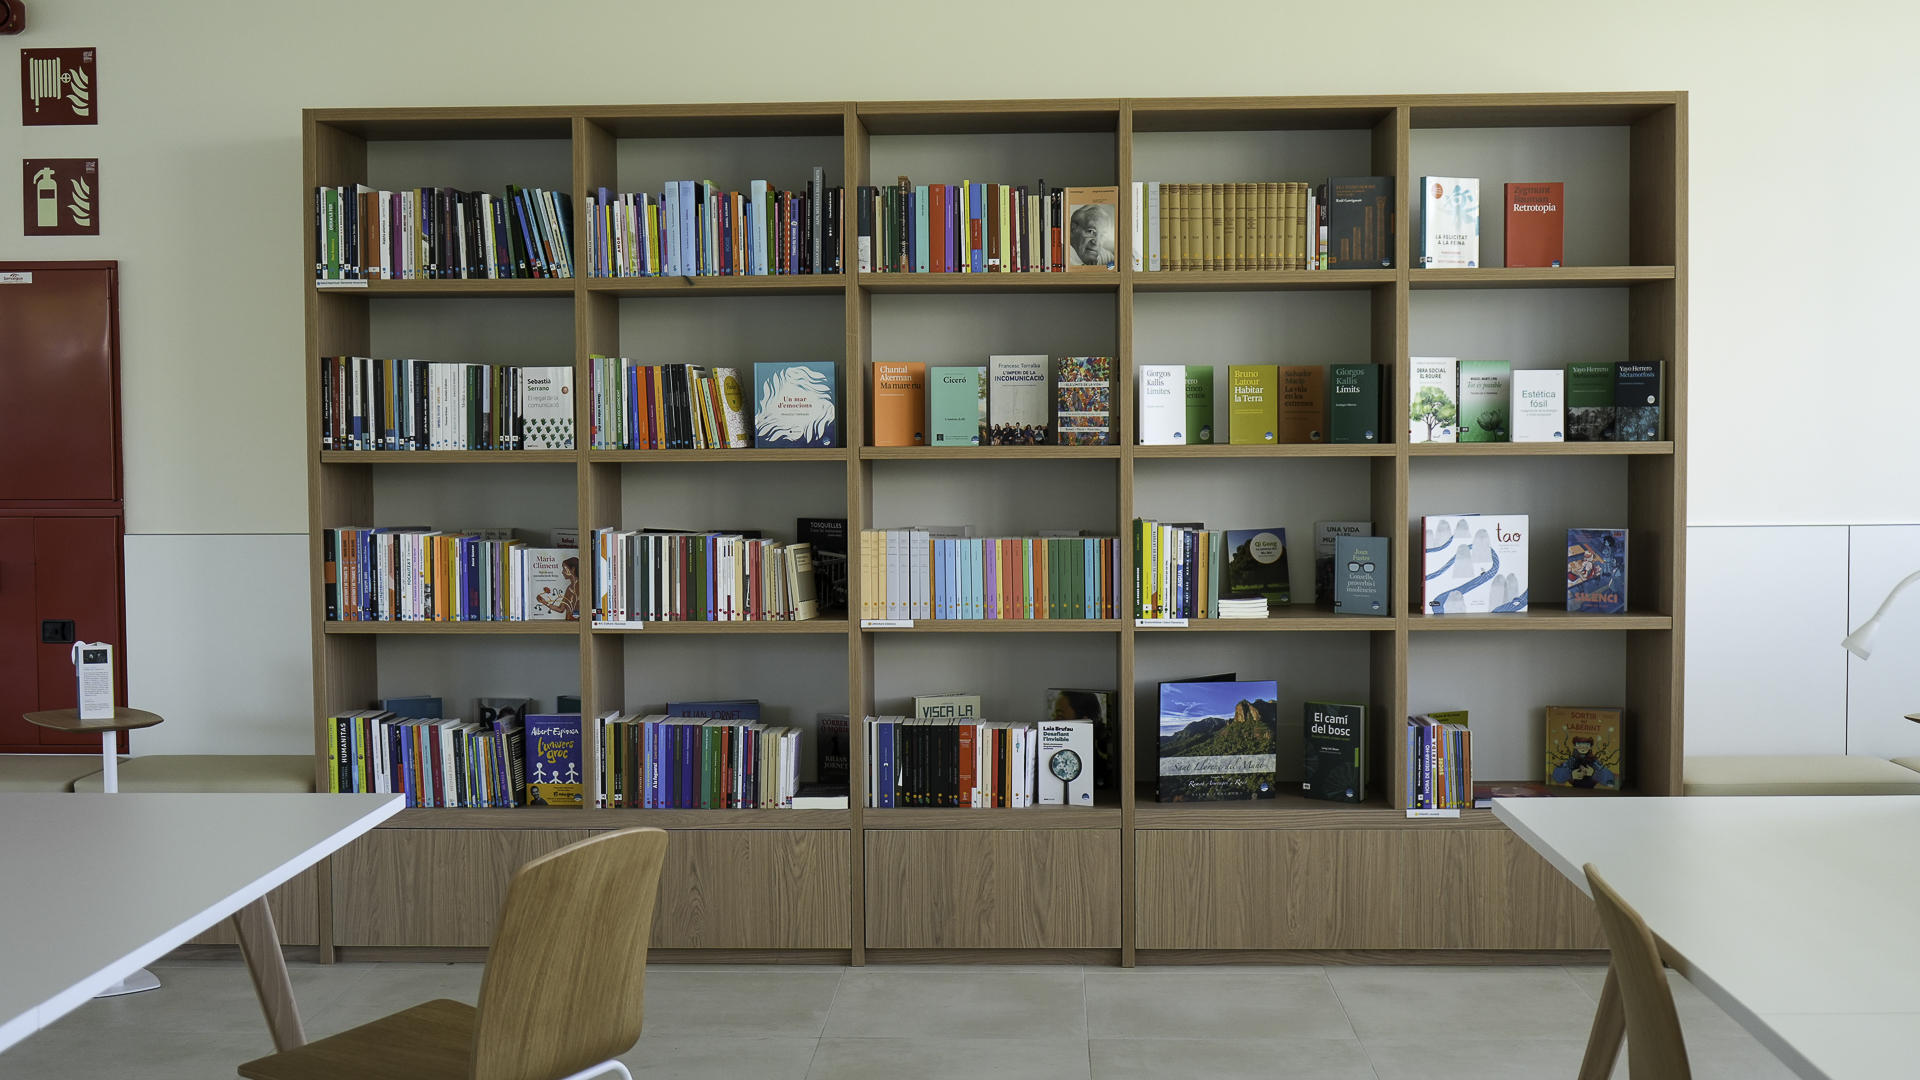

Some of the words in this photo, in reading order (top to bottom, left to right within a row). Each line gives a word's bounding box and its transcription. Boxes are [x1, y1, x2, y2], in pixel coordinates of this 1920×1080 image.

[1514, 186, 1550, 196] Zygmunt
[1513, 203, 1556, 214] Retrotopia
[1147, 370, 1171, 378] Giorgos
[1336, 368, 1365, 377] Giorgos
[1522, 390, 1556, 398] Estética
[1496, 523, 1522, 542] tao
[1574, 592, 1618, 603] SILENCI
[711, 710, 741, 720] JORNET
[922, 705, 954, 718] VISCA
[958, 704, 973, 717] LA
[822, 718, 848, 727] CÓRRER
[1315, 712, 1322, 722] El
[1325, 715, 1348, 724] camí
[531, 726, 552, 736] Albert
[553, 727, 579, 738] Espinosa
[1311, 724, 1326, 733] del
[1328, 725, 1350, 736] bosc
[1567, 724, 1601, 732] LABERINT
[546, 750, 568, 763] groc
[1172, 762, 1191, 772] Sant
[1193, 758, 1222, 772] Llorenç
[1224, 757, 1242, 770] del
